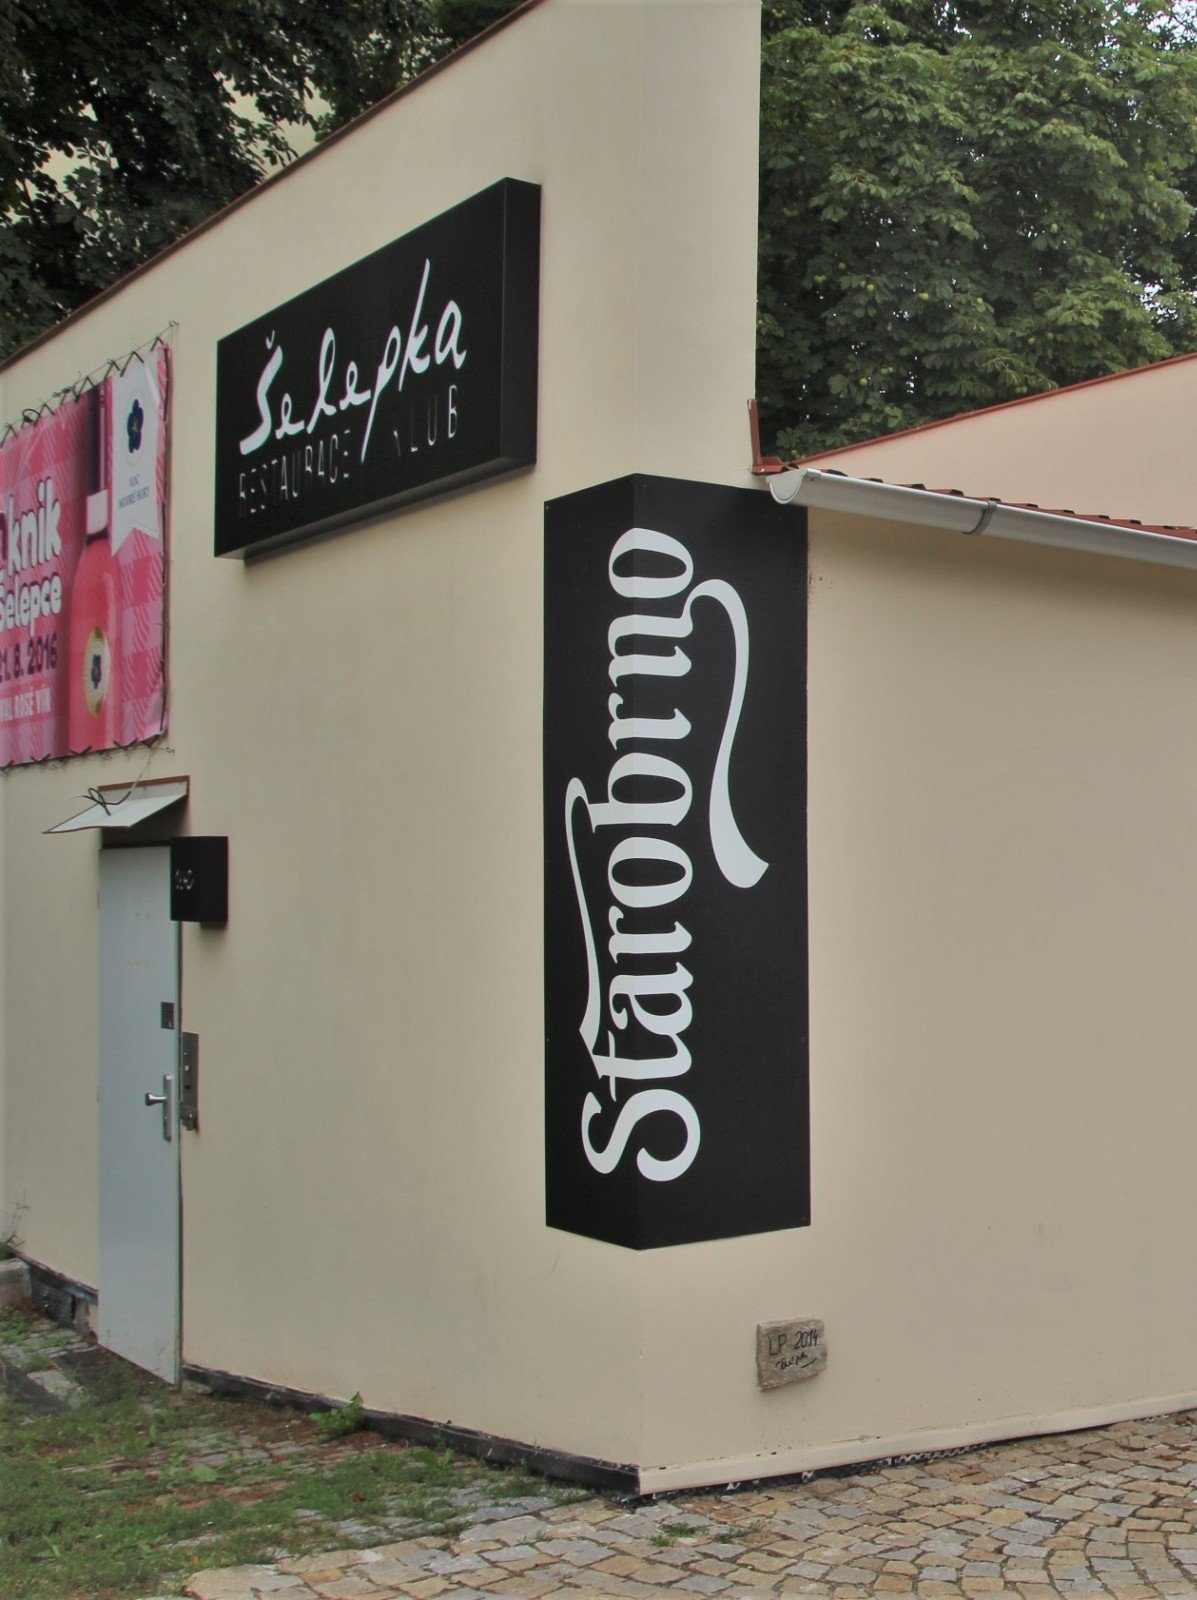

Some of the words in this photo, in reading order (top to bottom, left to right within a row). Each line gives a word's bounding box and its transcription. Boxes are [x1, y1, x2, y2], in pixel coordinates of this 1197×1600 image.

[239, 258, 467, 463] Šelepka
[27, 632, 58, 675] 2016
[565, 526, 769, 1183] Starobrno
